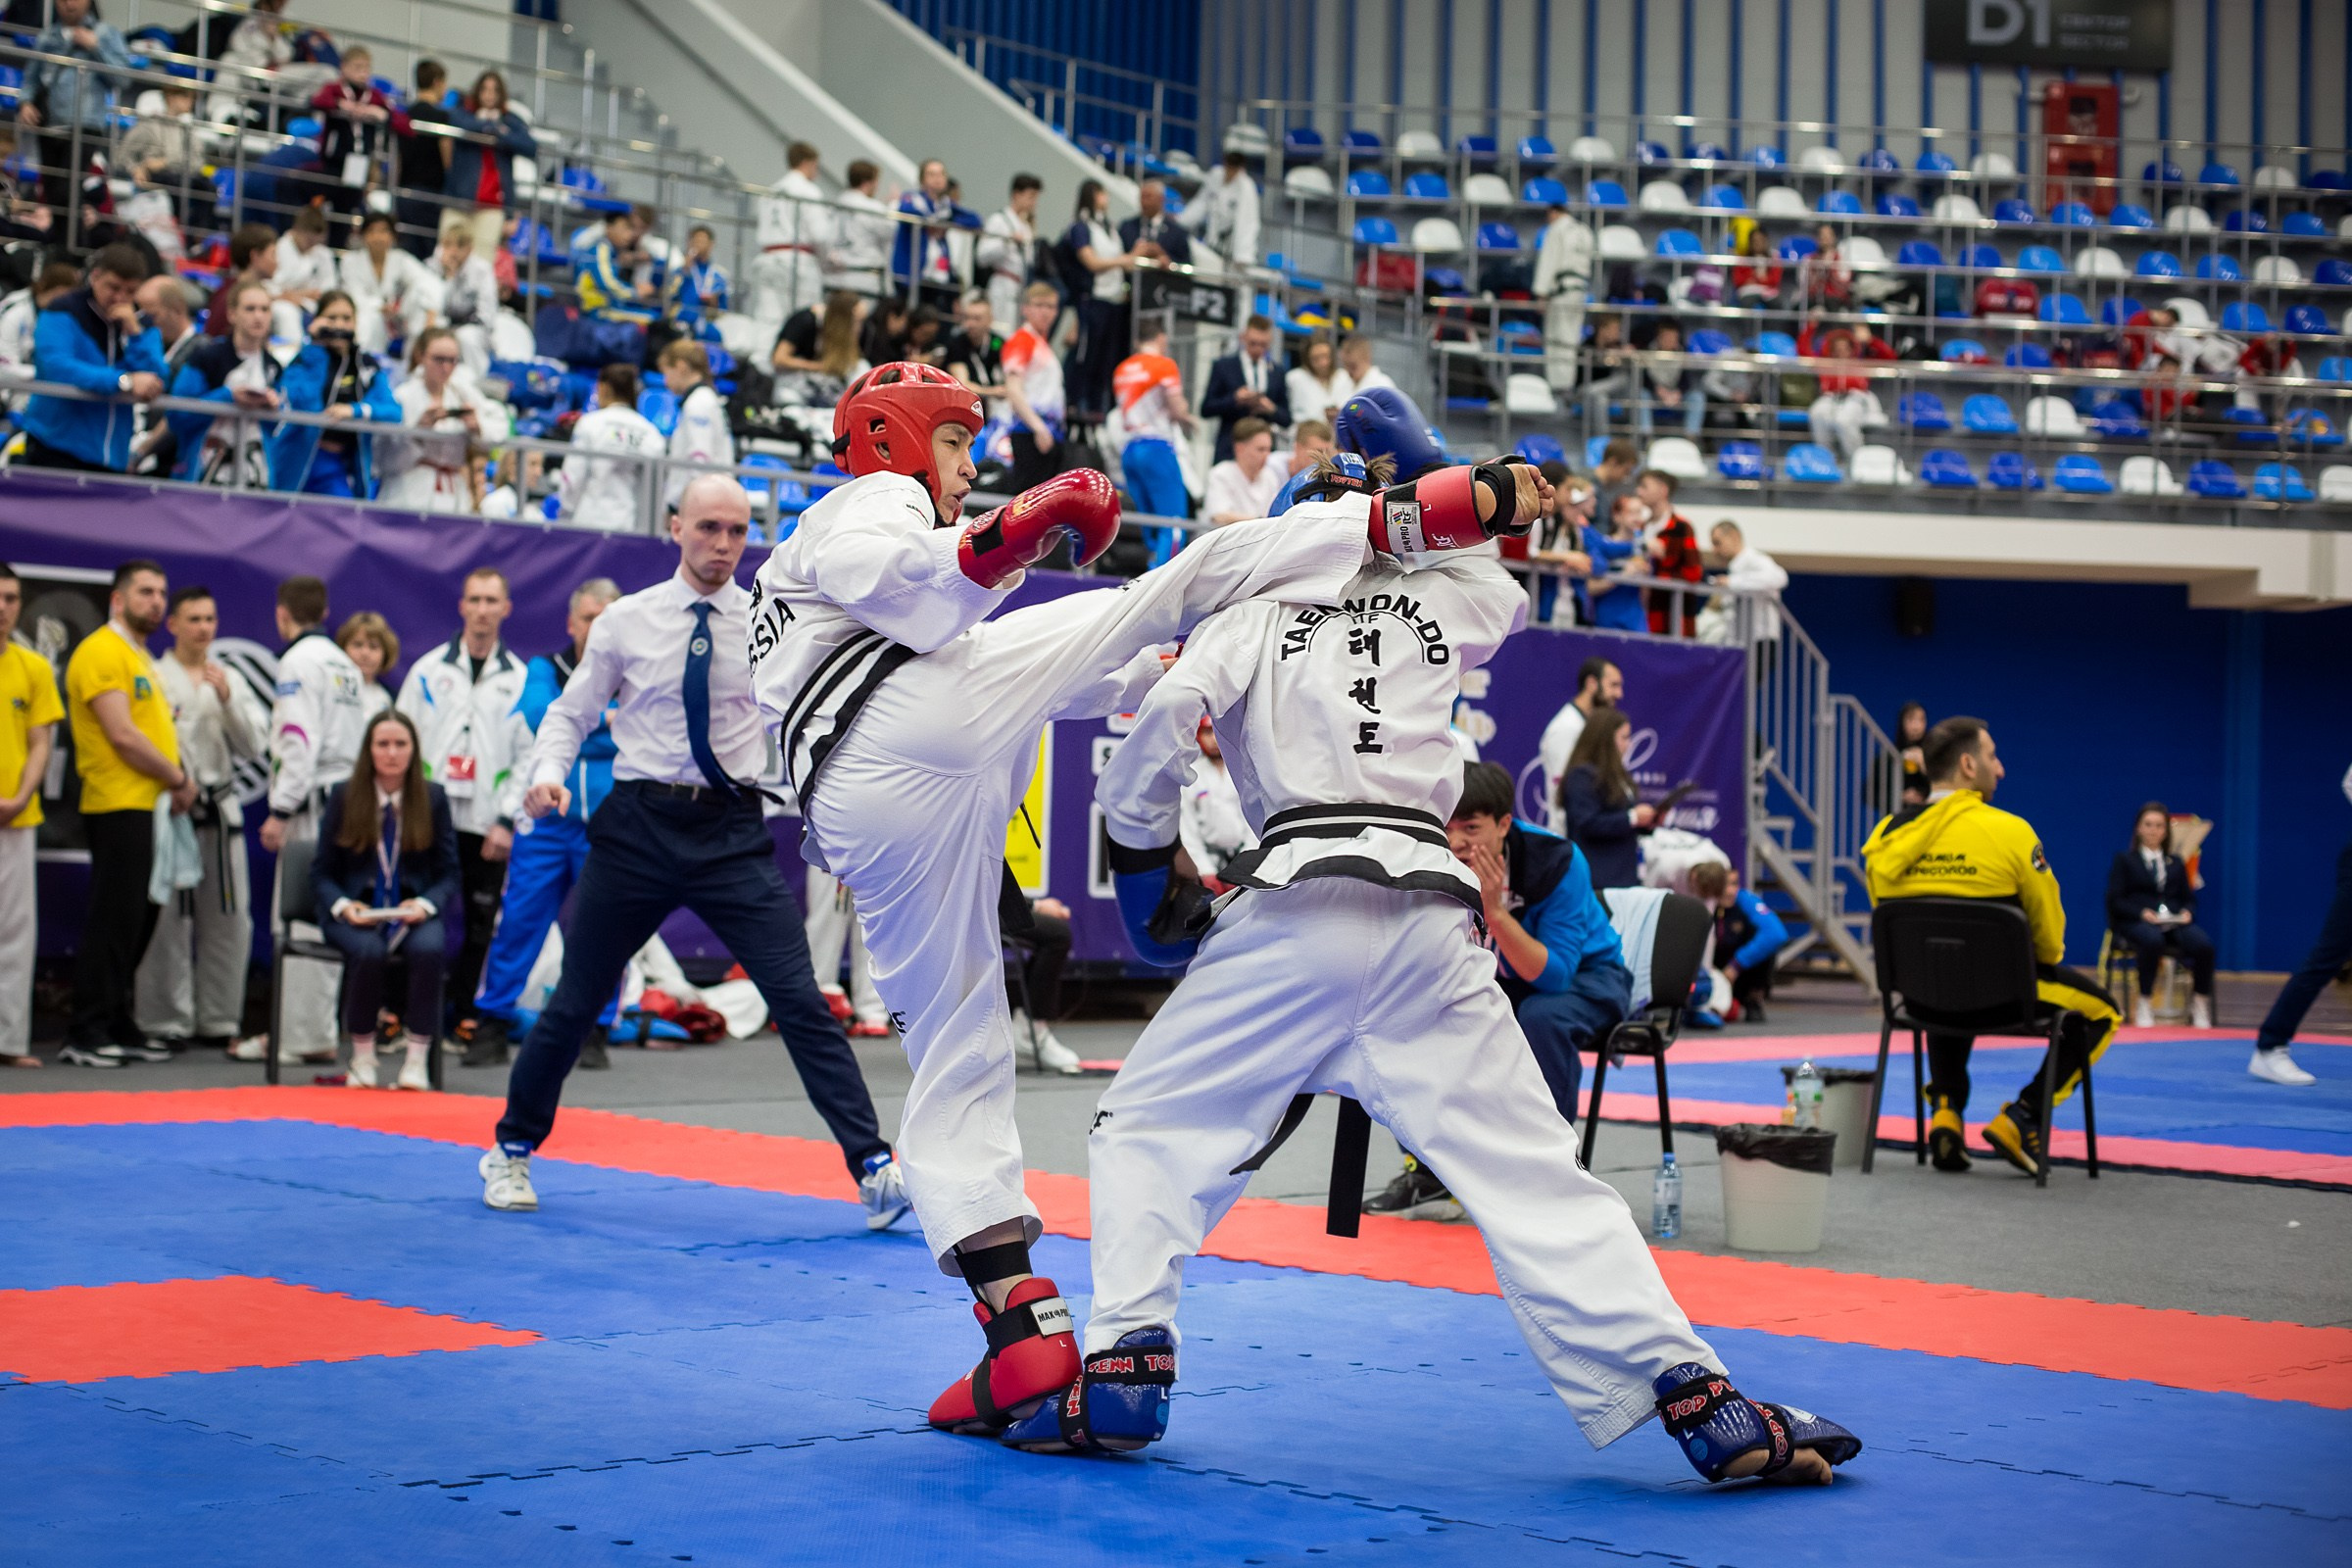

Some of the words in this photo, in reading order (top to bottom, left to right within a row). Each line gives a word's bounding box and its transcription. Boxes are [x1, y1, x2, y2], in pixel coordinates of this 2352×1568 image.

[1190, 287, 1226, 319] F2
[1058, 1339, 1067, 1348] L
[1160, 1387, 1168, 1400] L
[1667, 1395, 1707, 1422] TOP
